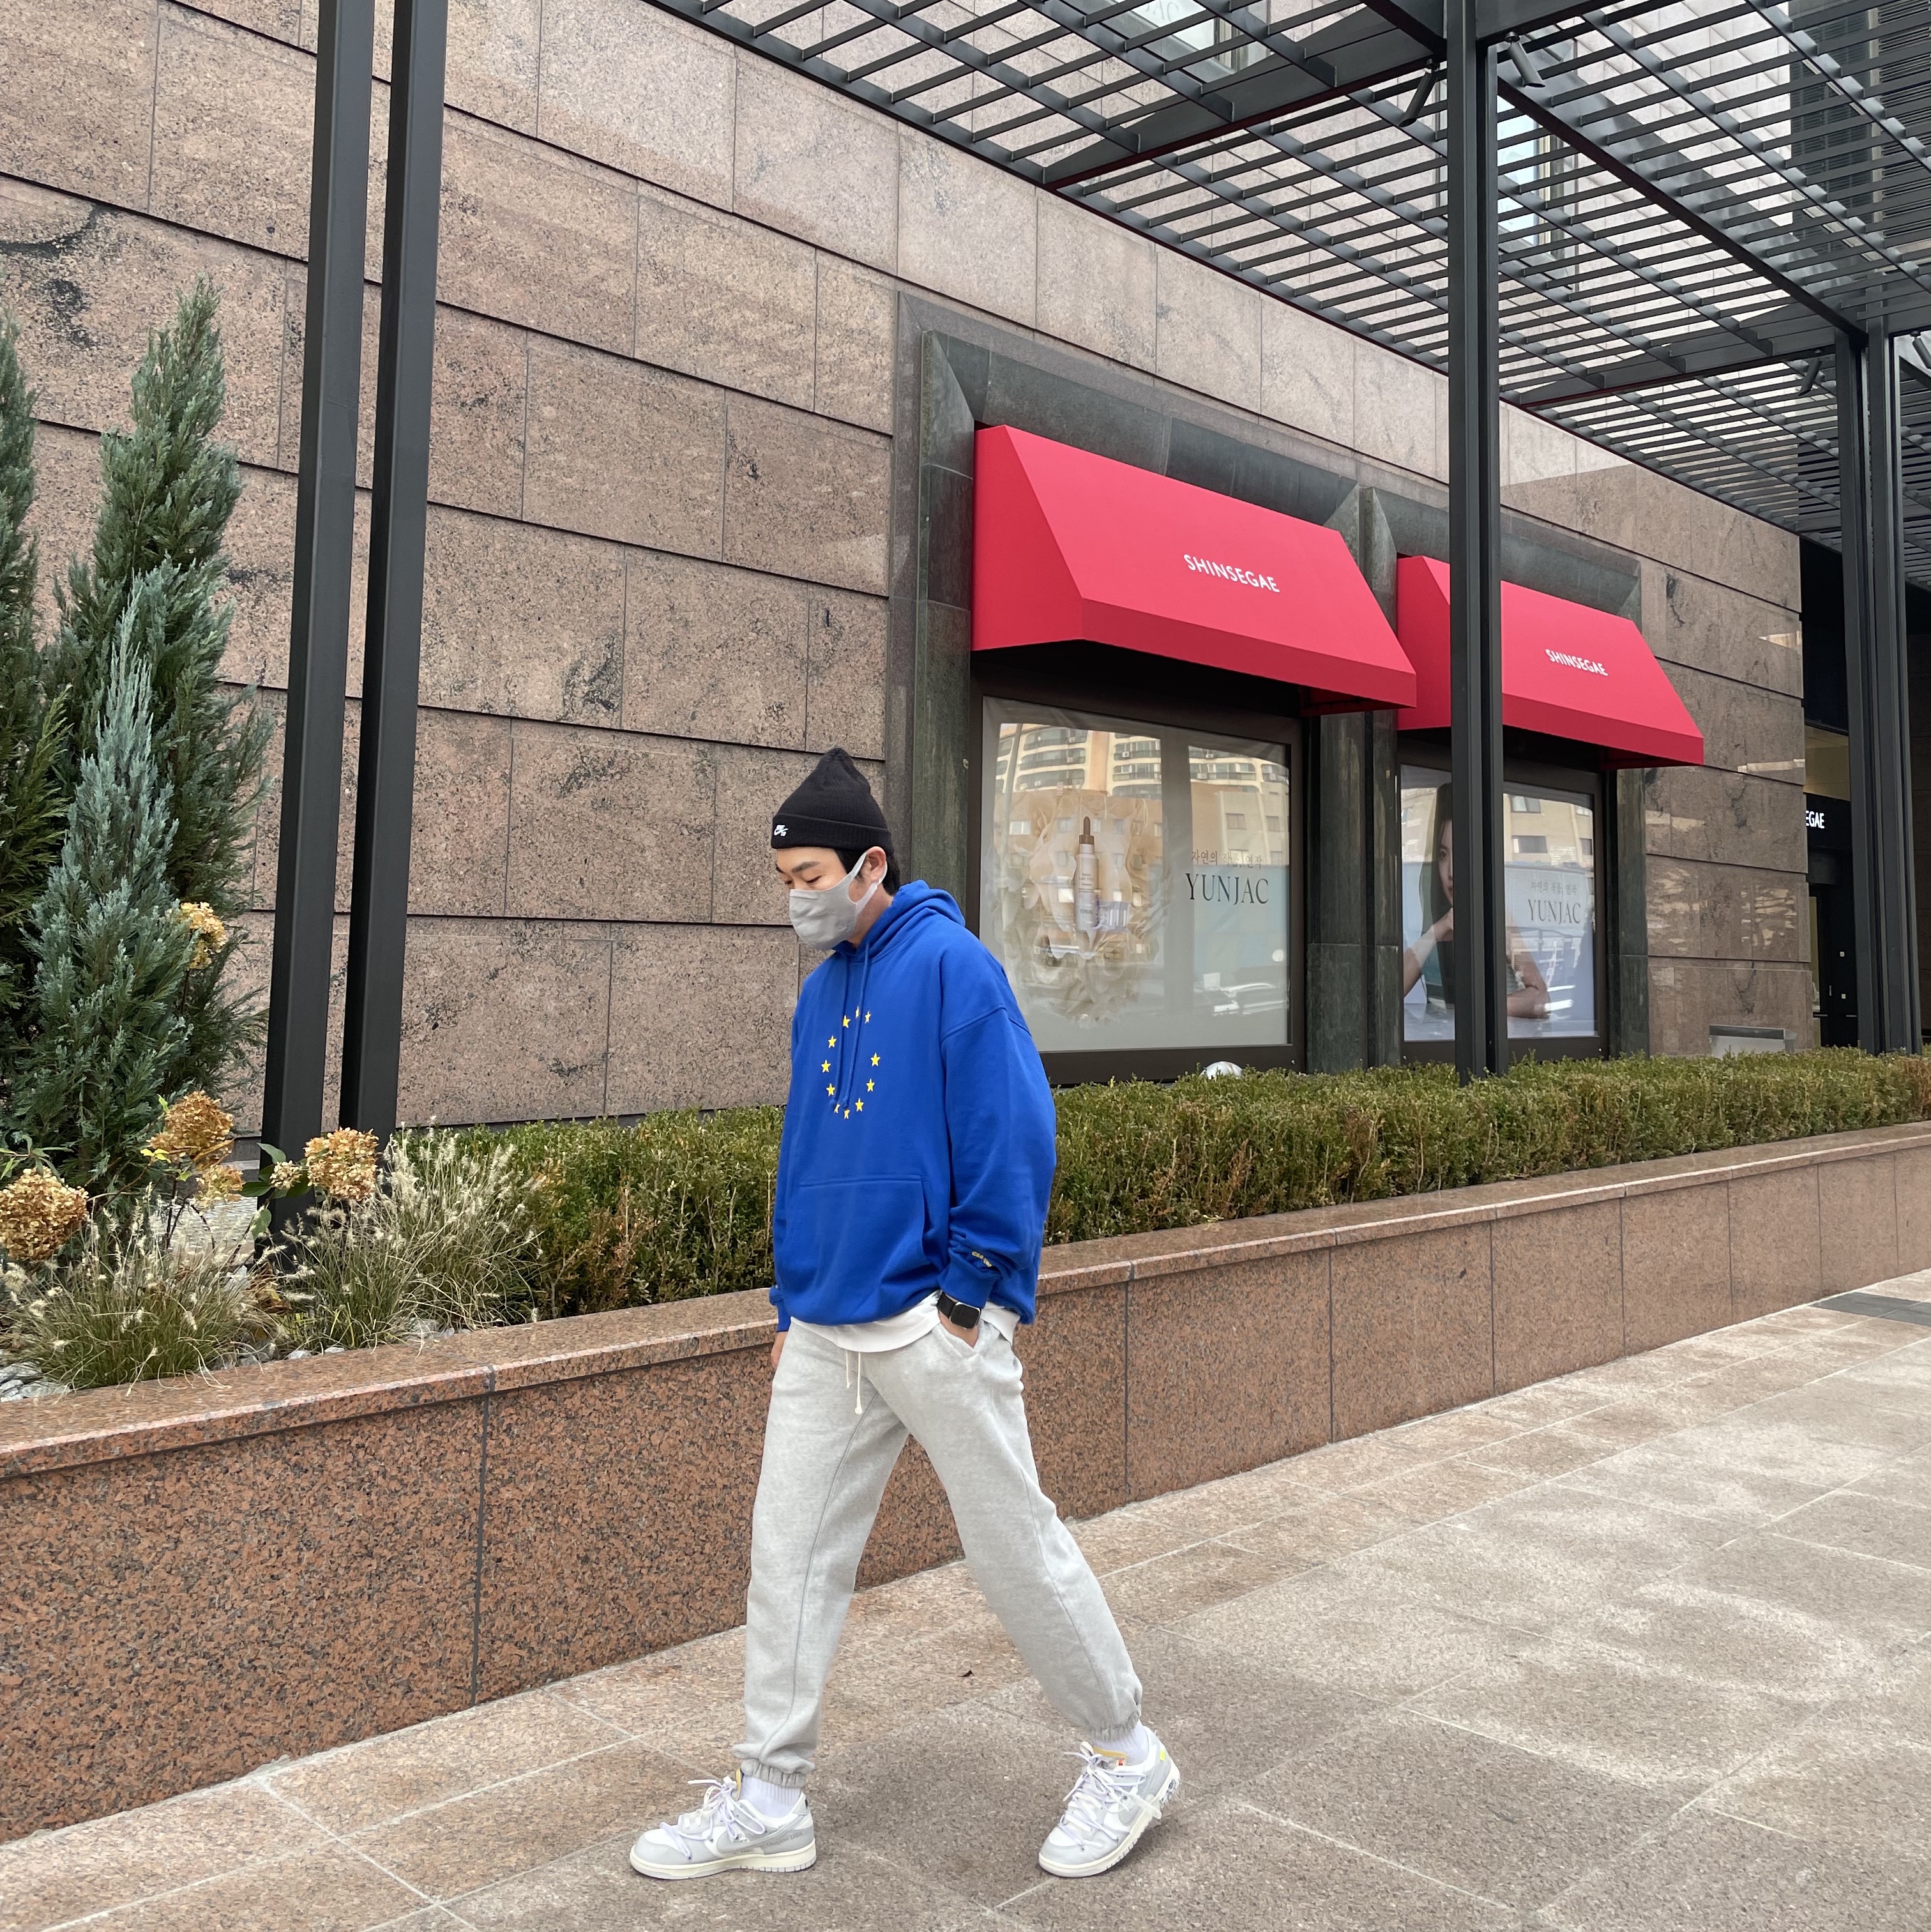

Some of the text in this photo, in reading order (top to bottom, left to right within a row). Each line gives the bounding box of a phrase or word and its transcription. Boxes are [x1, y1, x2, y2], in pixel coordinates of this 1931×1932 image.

[1183, 554, 1280, 593] SHINSEGAE
[1545, 649, 1609, 676] SHINSEGAE
[1191, 849, 1218, 865] 자연의
[1245, 855, 1263, 869] 연작
[1185, 872, 1269, 905] YUNJAC
[1527, 899, 1581, 924] YUNJAC
[790, 1832, 803, 1840] USA
